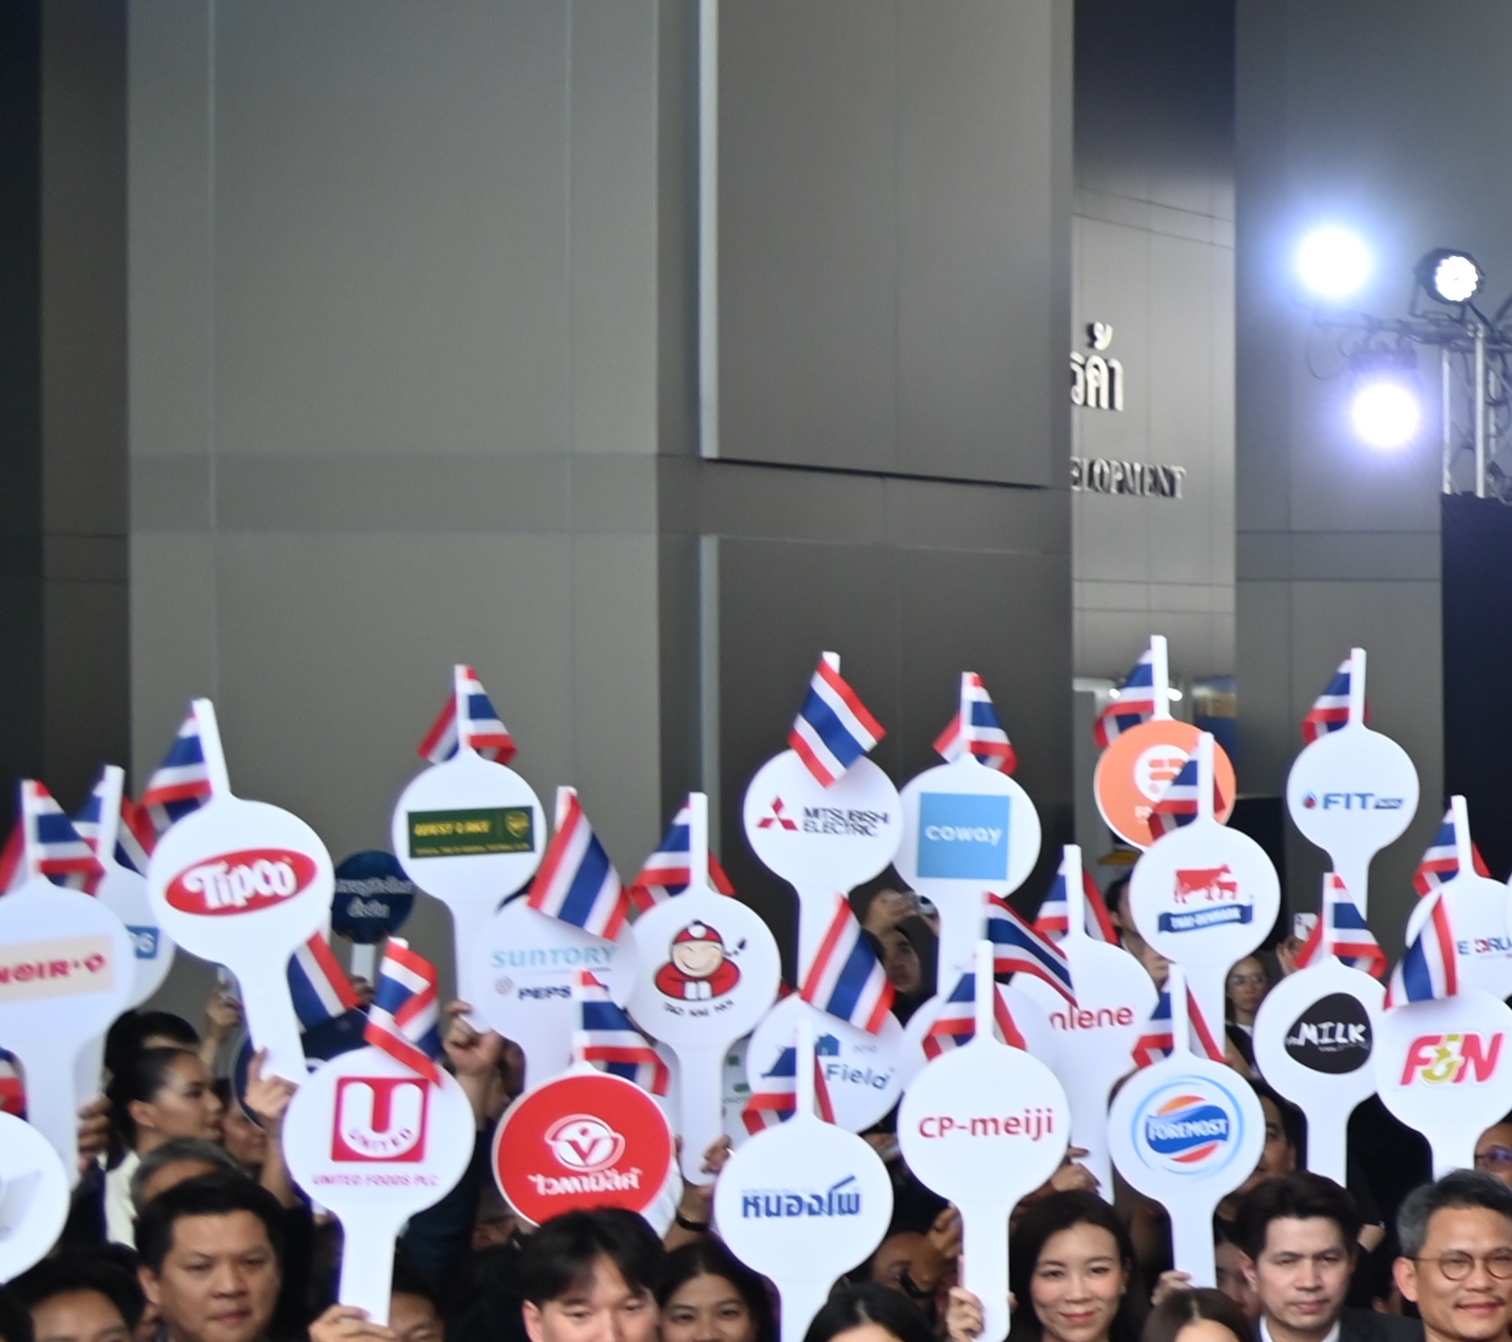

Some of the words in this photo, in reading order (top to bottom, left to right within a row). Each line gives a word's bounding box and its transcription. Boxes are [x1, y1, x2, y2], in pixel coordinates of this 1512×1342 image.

[1323, 792, 1374, 810] FIT
[803, 806, 890, 824] MITSUBISHI
[802, 820, 878, 838] ELECTRIC
[924, 824, 1003, 846] coway
[181, 859, 297, 909] Tipco
[491, 944, 617, 970] SUNTORY
[1049, 1005, 1133, 1032] nlene
[1400, 1032, 1505, 1087] F&N
[918, 1108, 1054, 1142] CP-meiji
[1148, 1118, 1229, 1142] FOREMOST
[741, 1173, 862, 1218] หนองโพ
